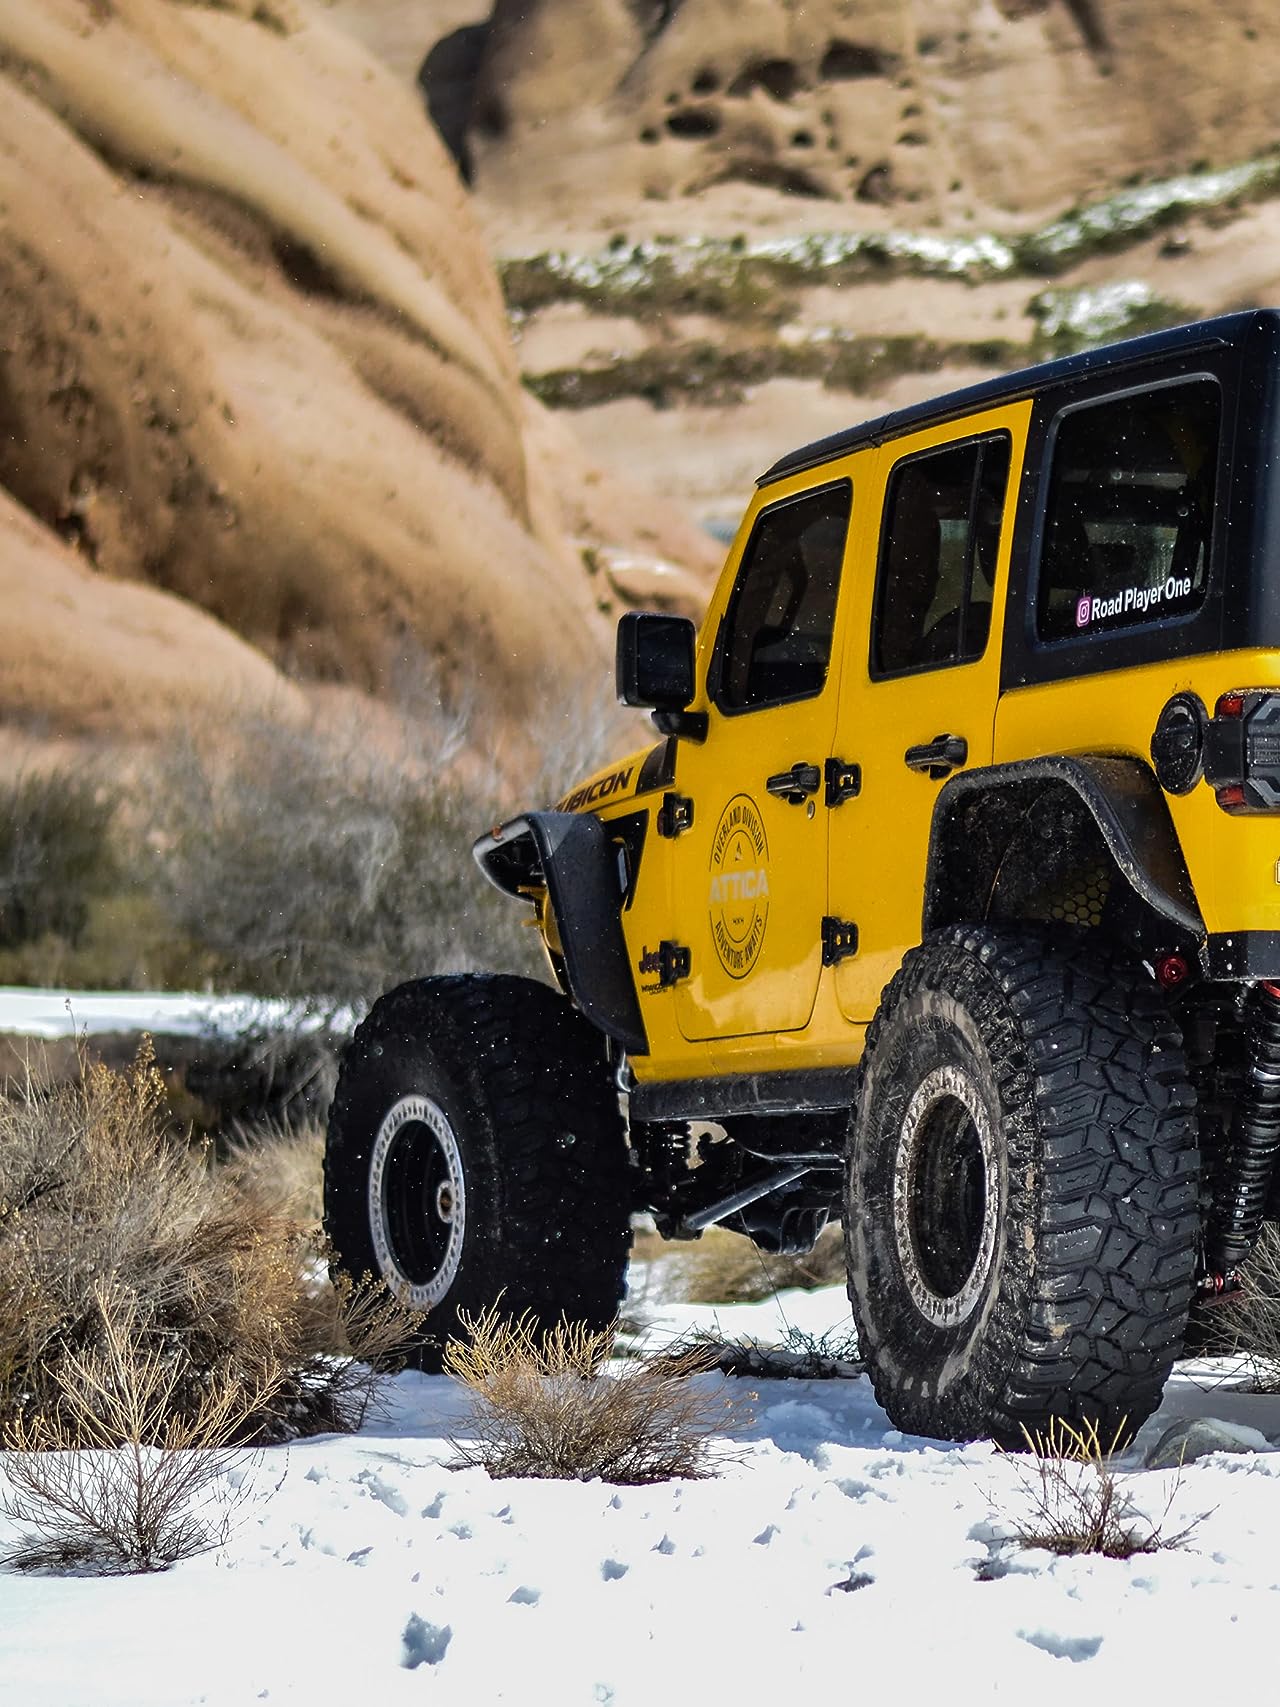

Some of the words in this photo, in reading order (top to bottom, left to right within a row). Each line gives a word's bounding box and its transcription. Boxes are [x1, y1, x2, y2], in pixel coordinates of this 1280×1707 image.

[1091, 591, 1122, 621] Road
[1124, 584, 1165, 612] Player
[1165, 576, 1191, 600] One
[552, 767, 634, 812] UBICON
[713, 805, 742, 865] OVERLAND
[742, 805, 765, 856] DIVISION
[709, 868, 770, 905] ATTICA
[713, 919, 744, 969] ADVENTURE
[744, 915, 764, 962] AWAITS
